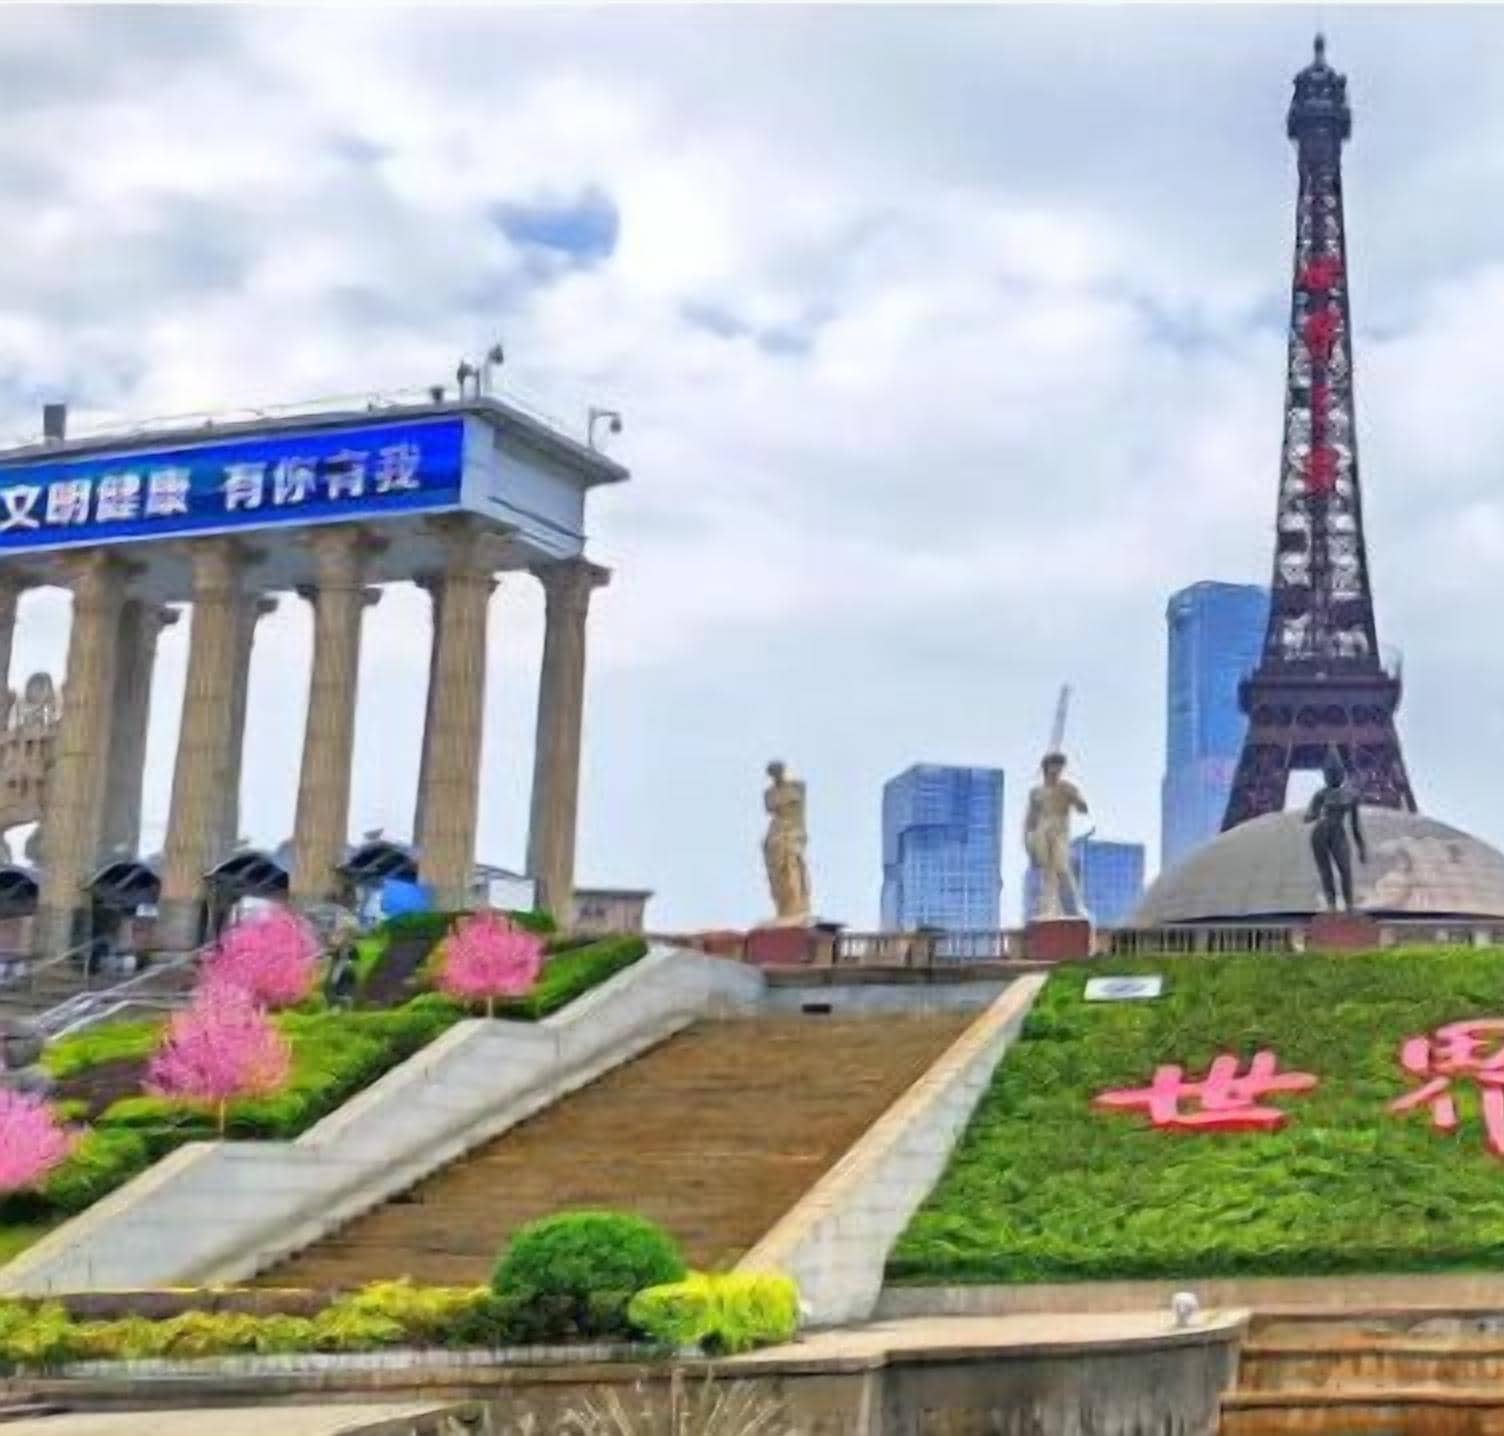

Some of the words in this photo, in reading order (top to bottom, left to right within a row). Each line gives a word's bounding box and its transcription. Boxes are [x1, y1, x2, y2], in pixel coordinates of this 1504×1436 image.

[0, 466, 190, 531] 文明健康
[224, 444, 420, 511] 有你有我
